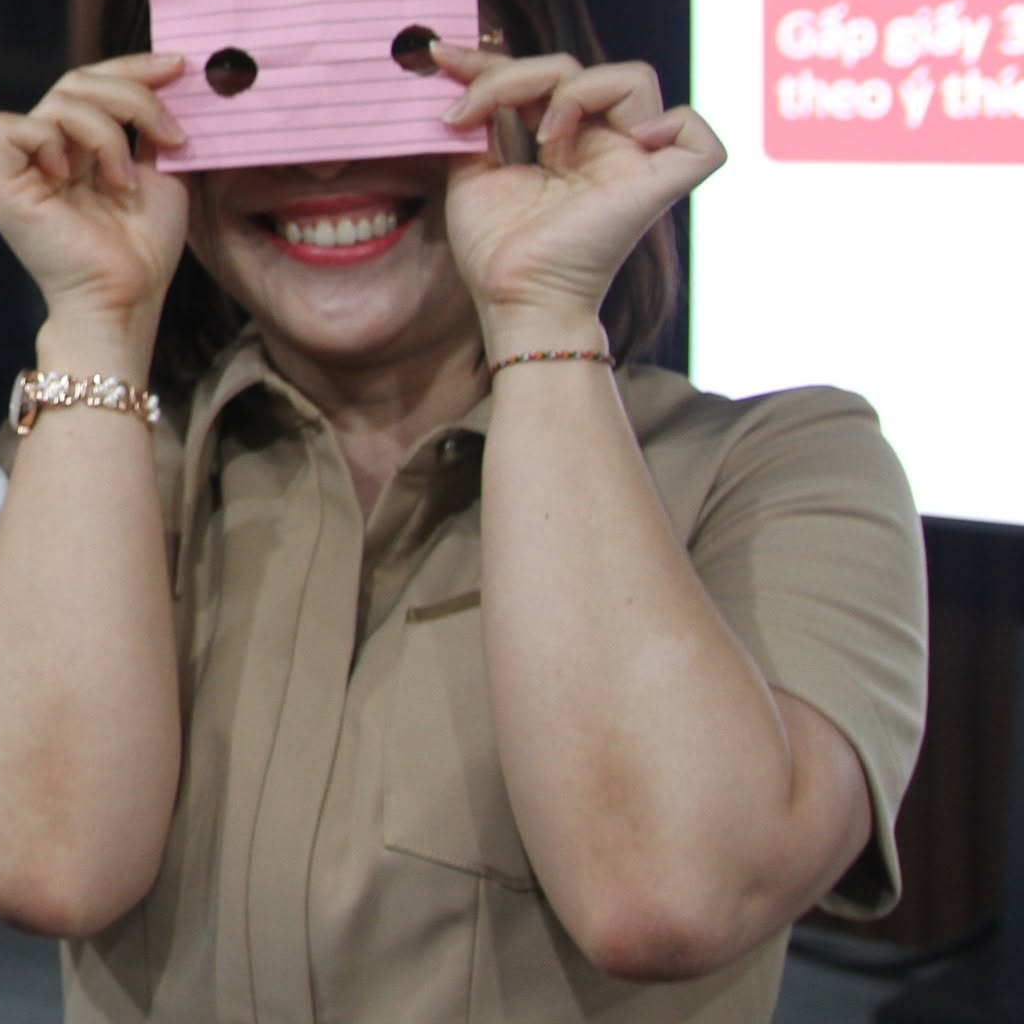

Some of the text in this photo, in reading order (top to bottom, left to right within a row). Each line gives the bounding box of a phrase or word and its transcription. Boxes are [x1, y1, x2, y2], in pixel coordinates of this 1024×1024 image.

[776, 0, 878, 67] Gấp
[776, 68, 893, 120] theo
[899, 64, 935, 131] ý
